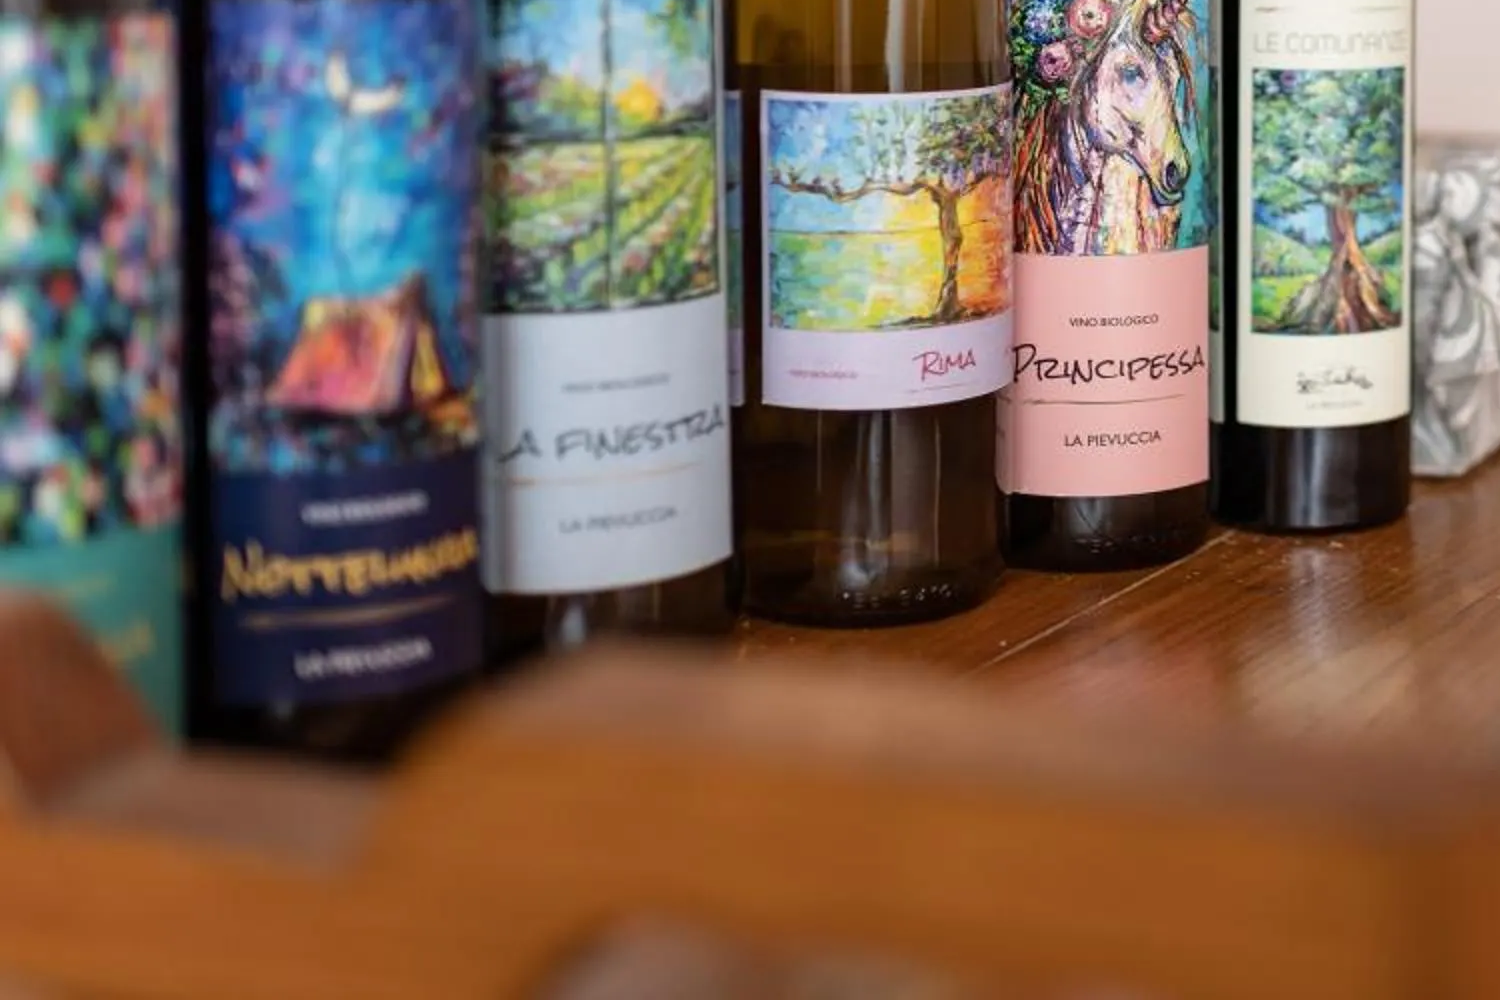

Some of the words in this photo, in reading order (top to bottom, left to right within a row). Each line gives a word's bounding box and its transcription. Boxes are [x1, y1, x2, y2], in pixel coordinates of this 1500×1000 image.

[1253, 31, 1279, 54] LE
[1069, 316, 1098, 328] VINO
[1100, 313, 1159, 328] BIOLOGICO
[913, 349, 976, 380] RIMA
[1011, 343, 1205, 385] PRINCIPESSA
[555, 403, 725, 461] FINESTRA
[1064, 434, 1082, 447] LA
[1087, 430, 1161, 447] PIEVUCCIA
